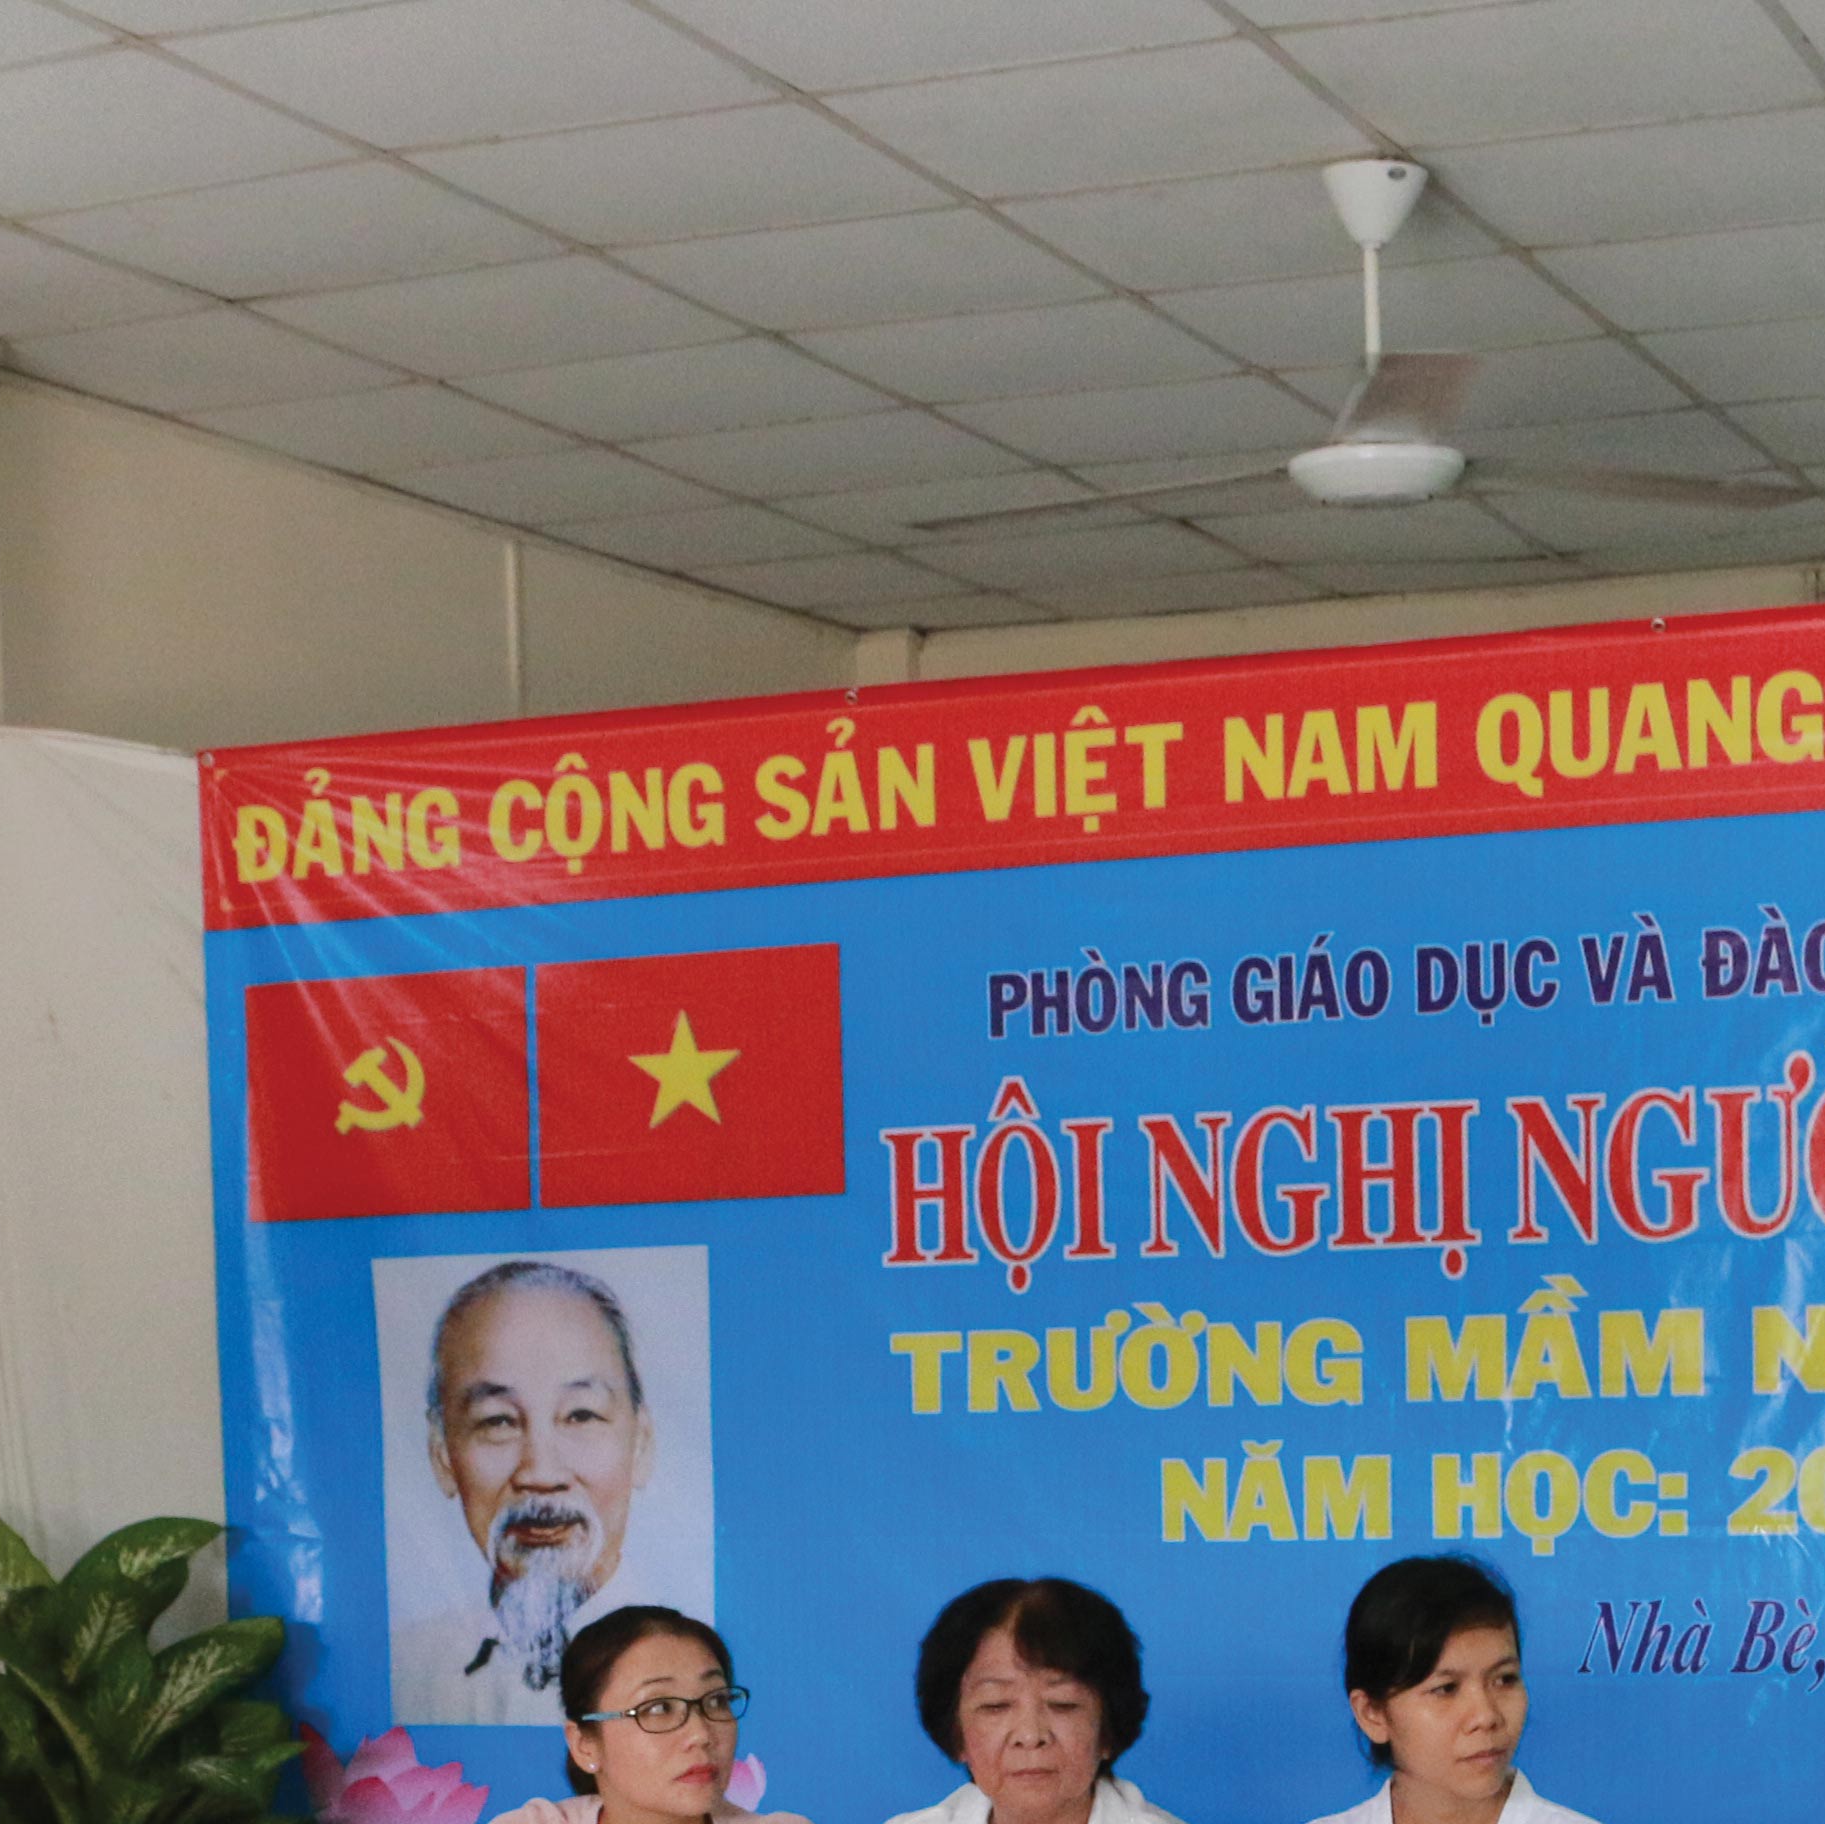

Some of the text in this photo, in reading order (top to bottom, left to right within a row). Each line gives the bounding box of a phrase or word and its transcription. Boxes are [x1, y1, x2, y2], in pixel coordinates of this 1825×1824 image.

[233, 767, 463, 884] ĐẢNG
[488, 752, 726, 876] CỘNG
[753, 718, 935, 841] SẢN
[968, 706, 1183, 834] VIỆT
[1222, 701, 1438, 803] NAM
[1476, 670, 1825, 797] QUANG
[988, 948, 1210, 1039] PHÒNG
[1233, 933, 1391, 1022] GIÁO
[1415, 937, 1557, 1028] DỤC
[1580, 911, 1674, 1006] VÀ
[879, 1076, 1115, 1294] HỘI
[1141, 1100, 1480, 1281] NGHỊ
[890, 1302, 1364, 1414] TRƯỜNG
[1405, 1274, 1706, 1401] MẦM
[1162, 1440, 1391, 1543] NĂM
[1431, 1446, 1688, 1557] HỌC:
[1577, 1598, 1710, 1676] Nhà
